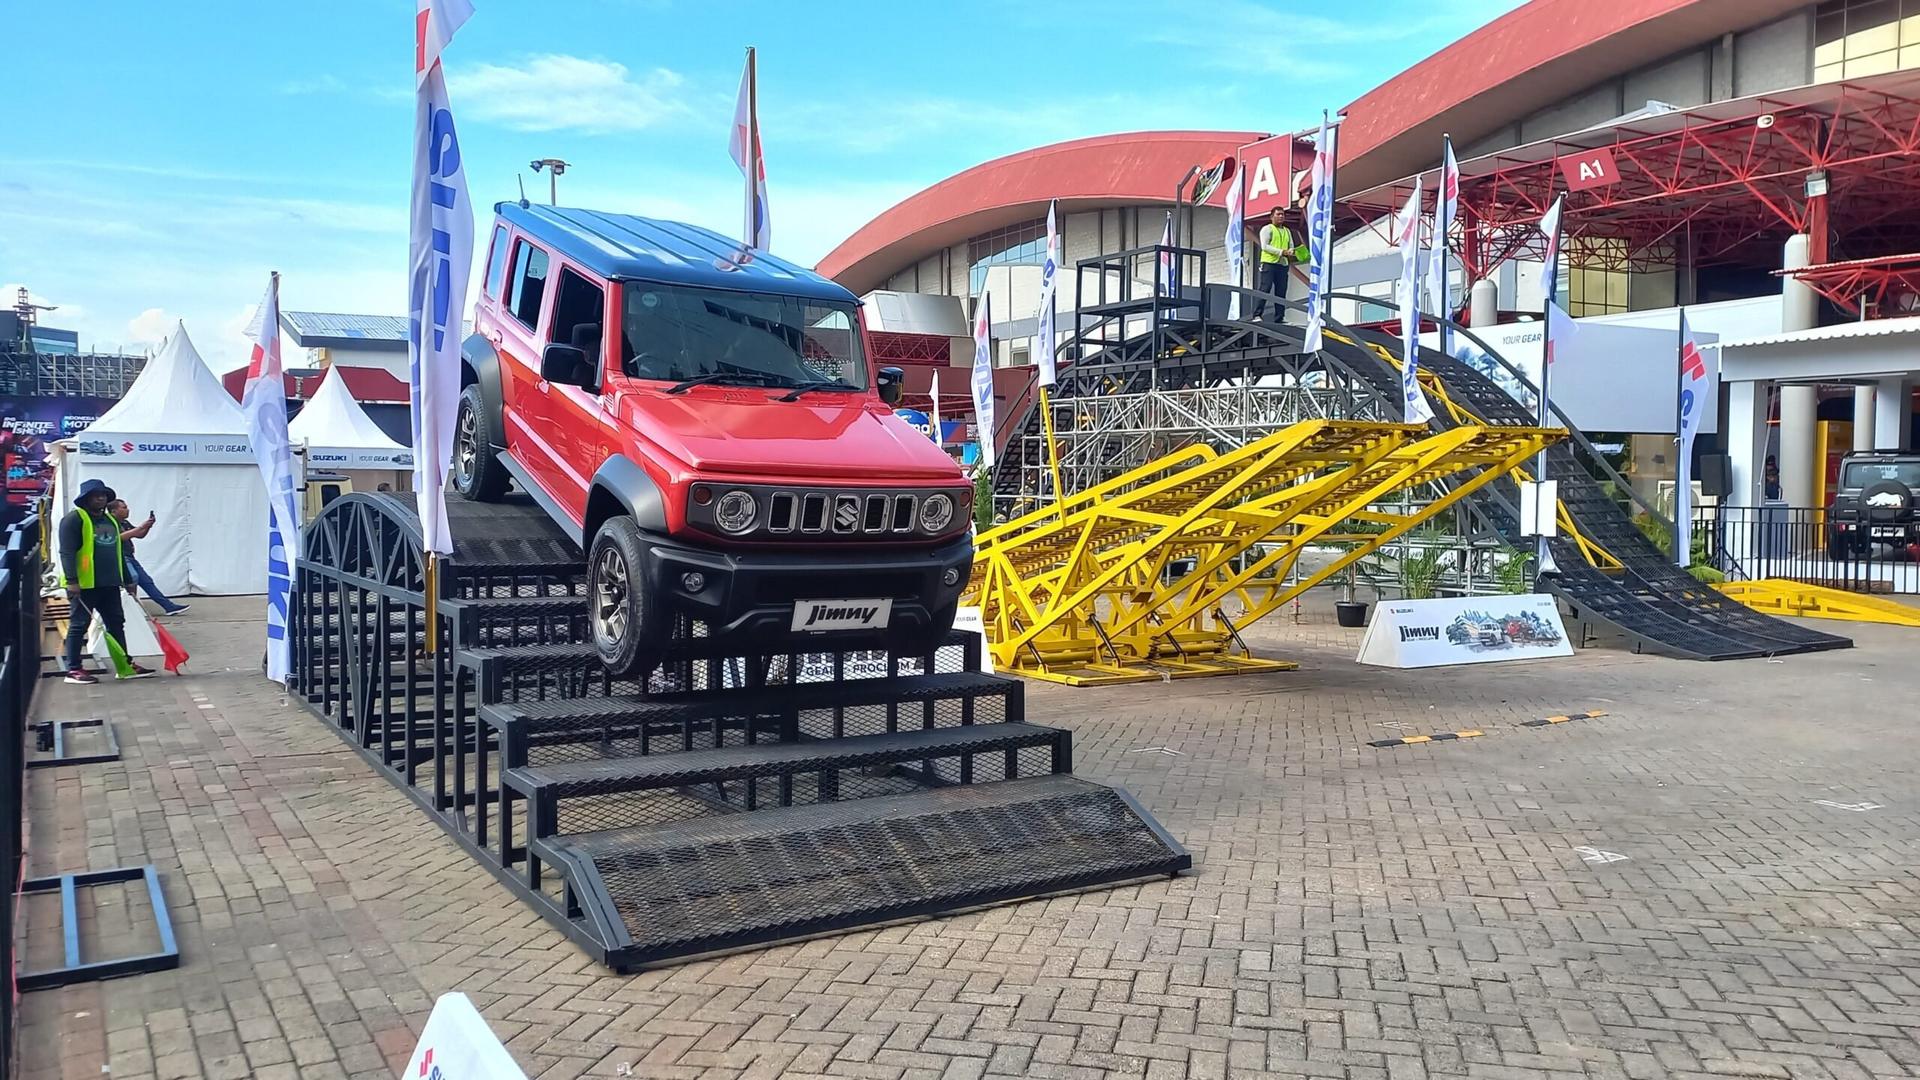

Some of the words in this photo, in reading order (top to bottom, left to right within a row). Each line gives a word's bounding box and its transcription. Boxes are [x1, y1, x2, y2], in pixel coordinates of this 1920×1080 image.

[1248, 156, 1279, 201] A
[1580, 159, 1605, 181] A1
[1503, 335, 1520, 345] YOUR
[1521, 333, 1542, 344] GEAR
[138, 444, 187, 452] SUZUKI
[225, 445, 247, 453] GEAR
[805, 605, 878, 626] Jimny
[1399, 625, 1440, 642] Jimny
